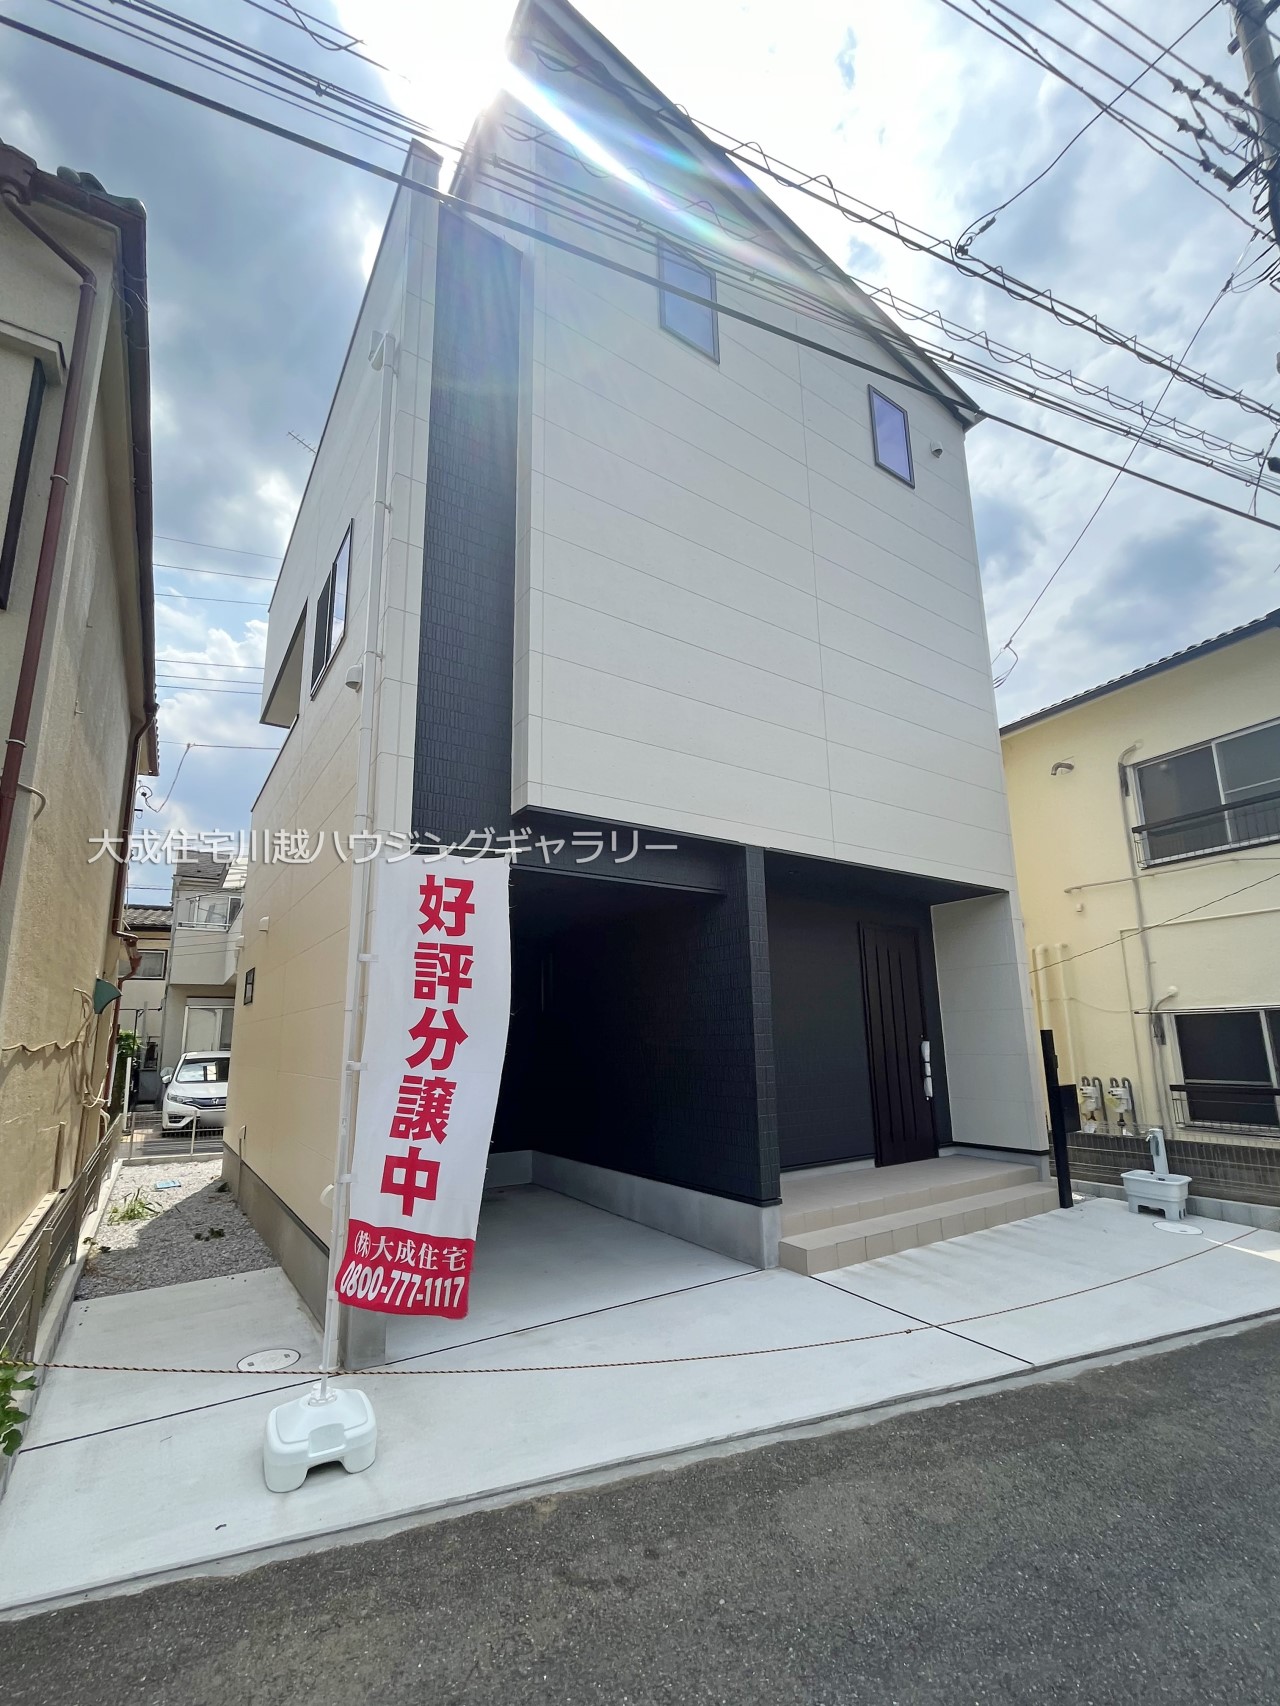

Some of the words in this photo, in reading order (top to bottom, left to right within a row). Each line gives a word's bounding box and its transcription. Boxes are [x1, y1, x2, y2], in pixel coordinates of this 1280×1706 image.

[380, 874, 476, 1217] 好評分譲中
[340, 1260, 465, 1308] 0800-777-1117
